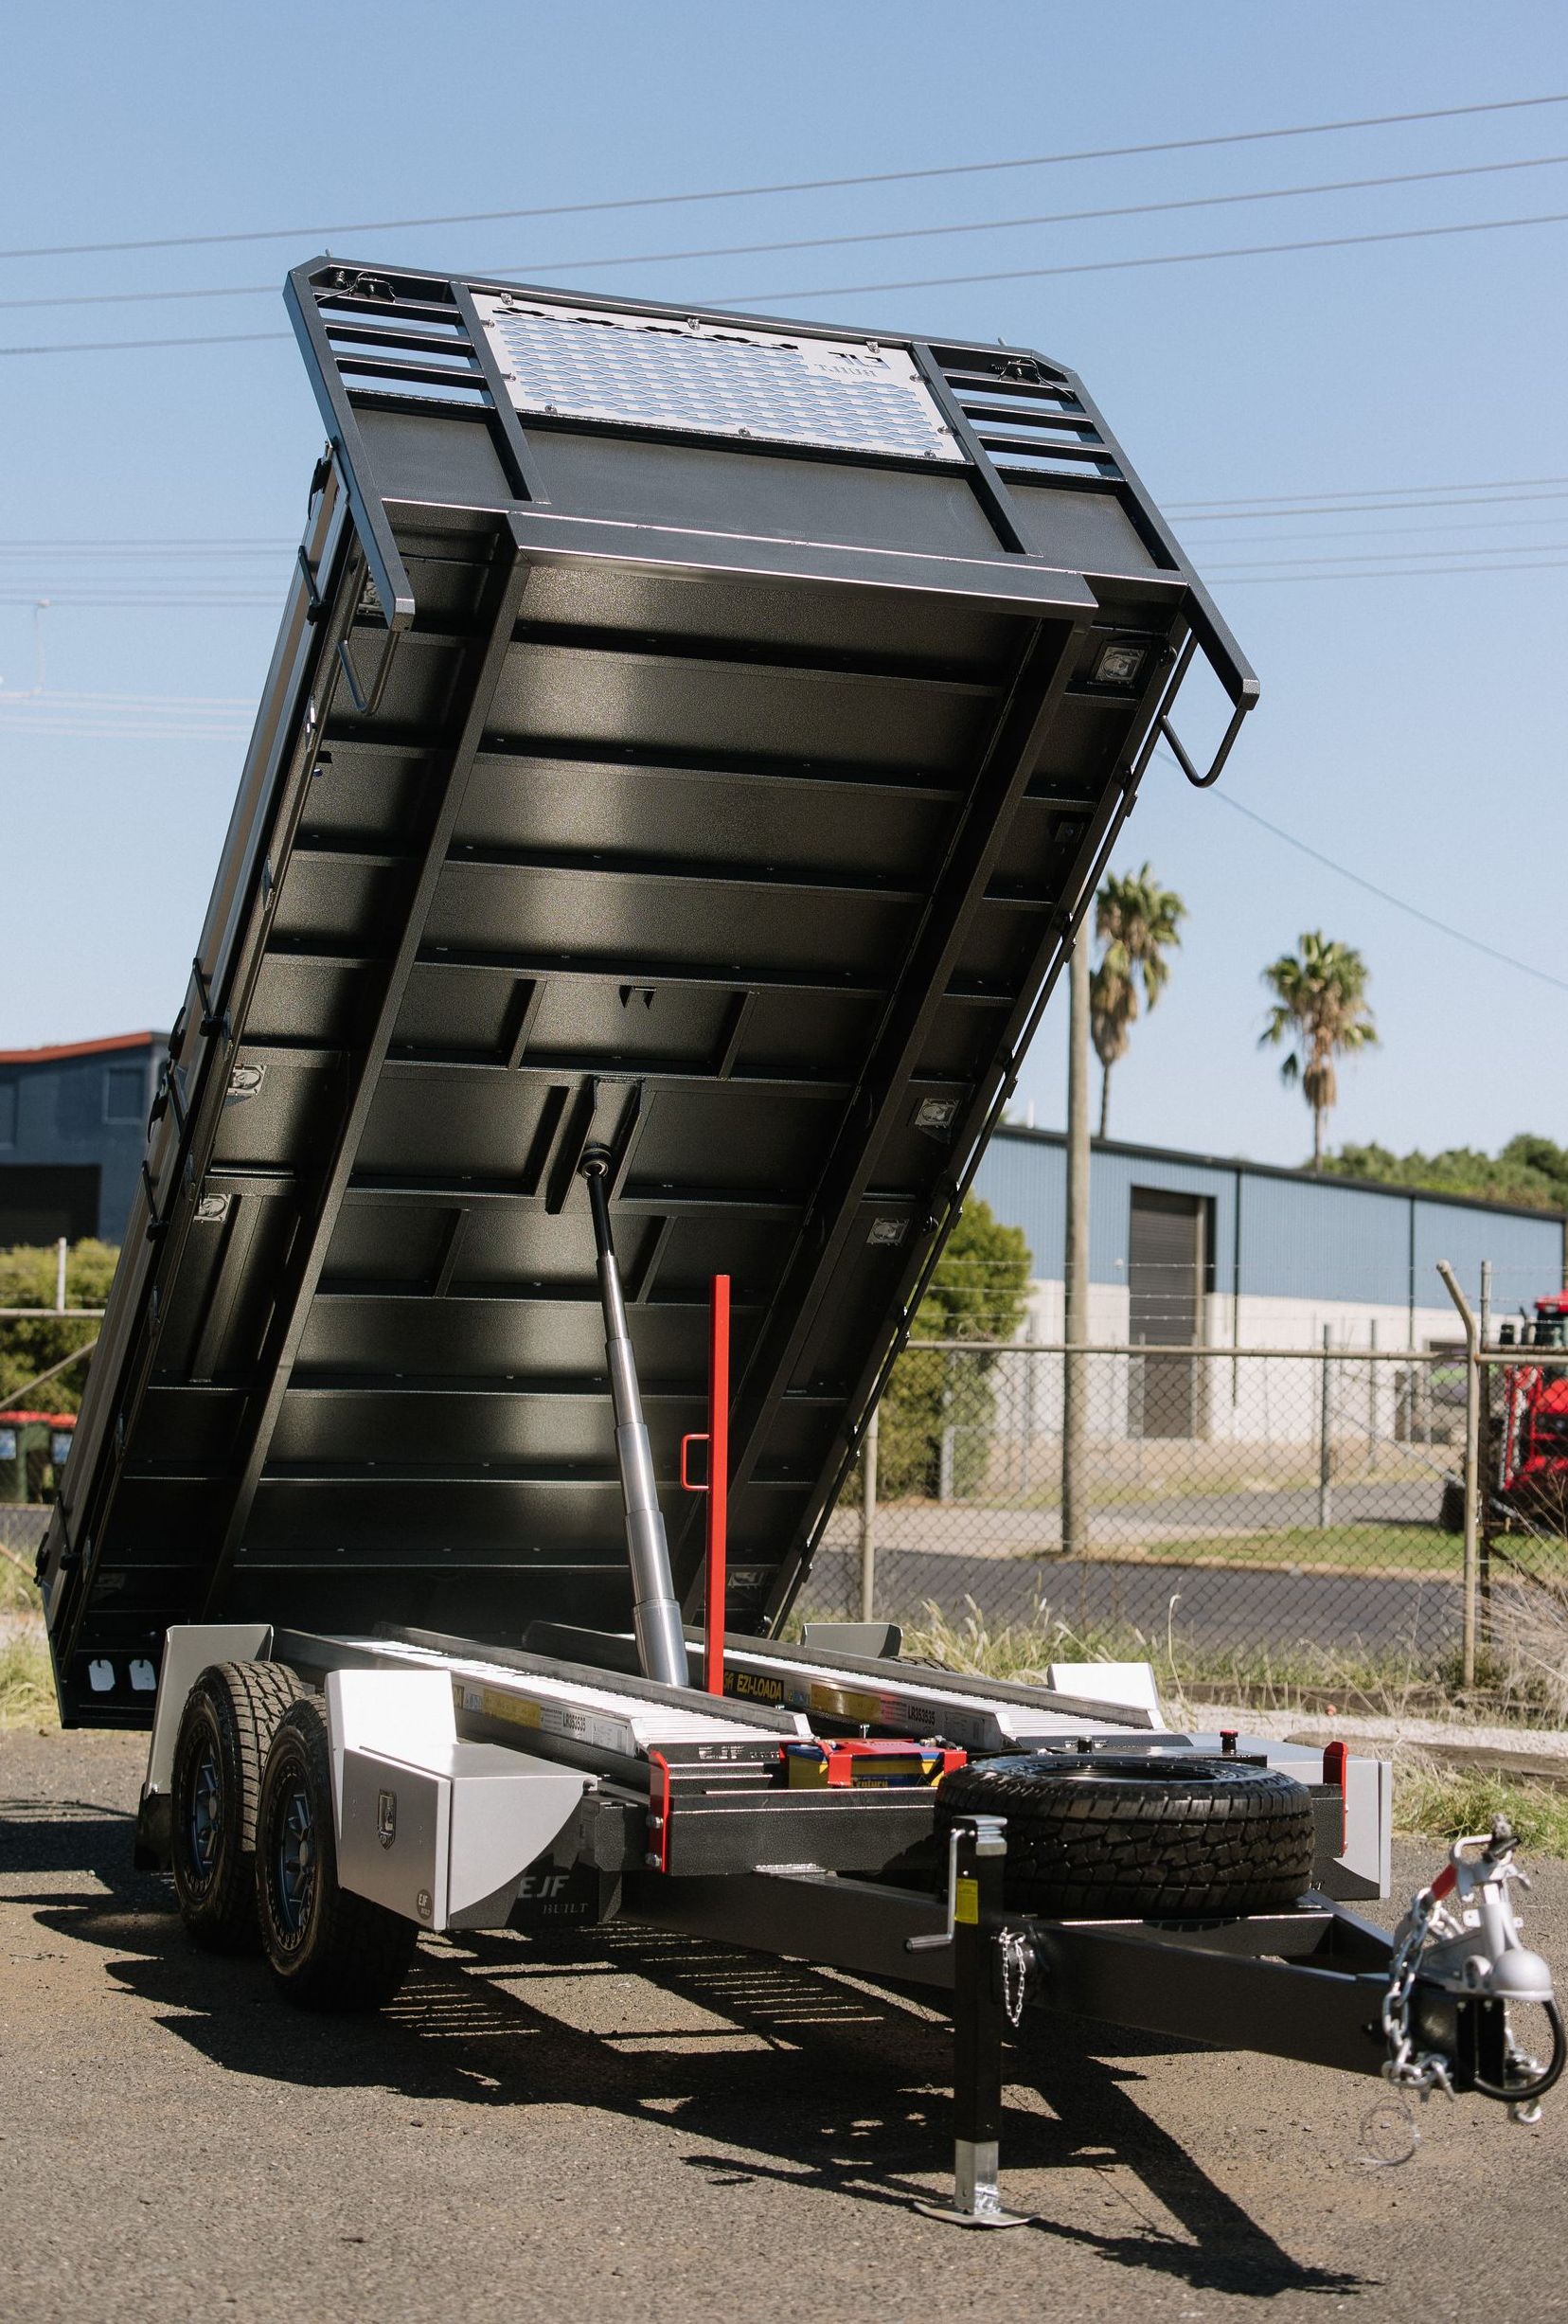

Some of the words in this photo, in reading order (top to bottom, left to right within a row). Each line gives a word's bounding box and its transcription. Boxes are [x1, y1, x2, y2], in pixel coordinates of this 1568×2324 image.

[736, 1672, 783, 1702] EZI-LOADA
[698, 1745, 744, 1760] EJF
[516, 1875, 570, 1899] EJF
[542, 1902, 589, 1914] BUILT
